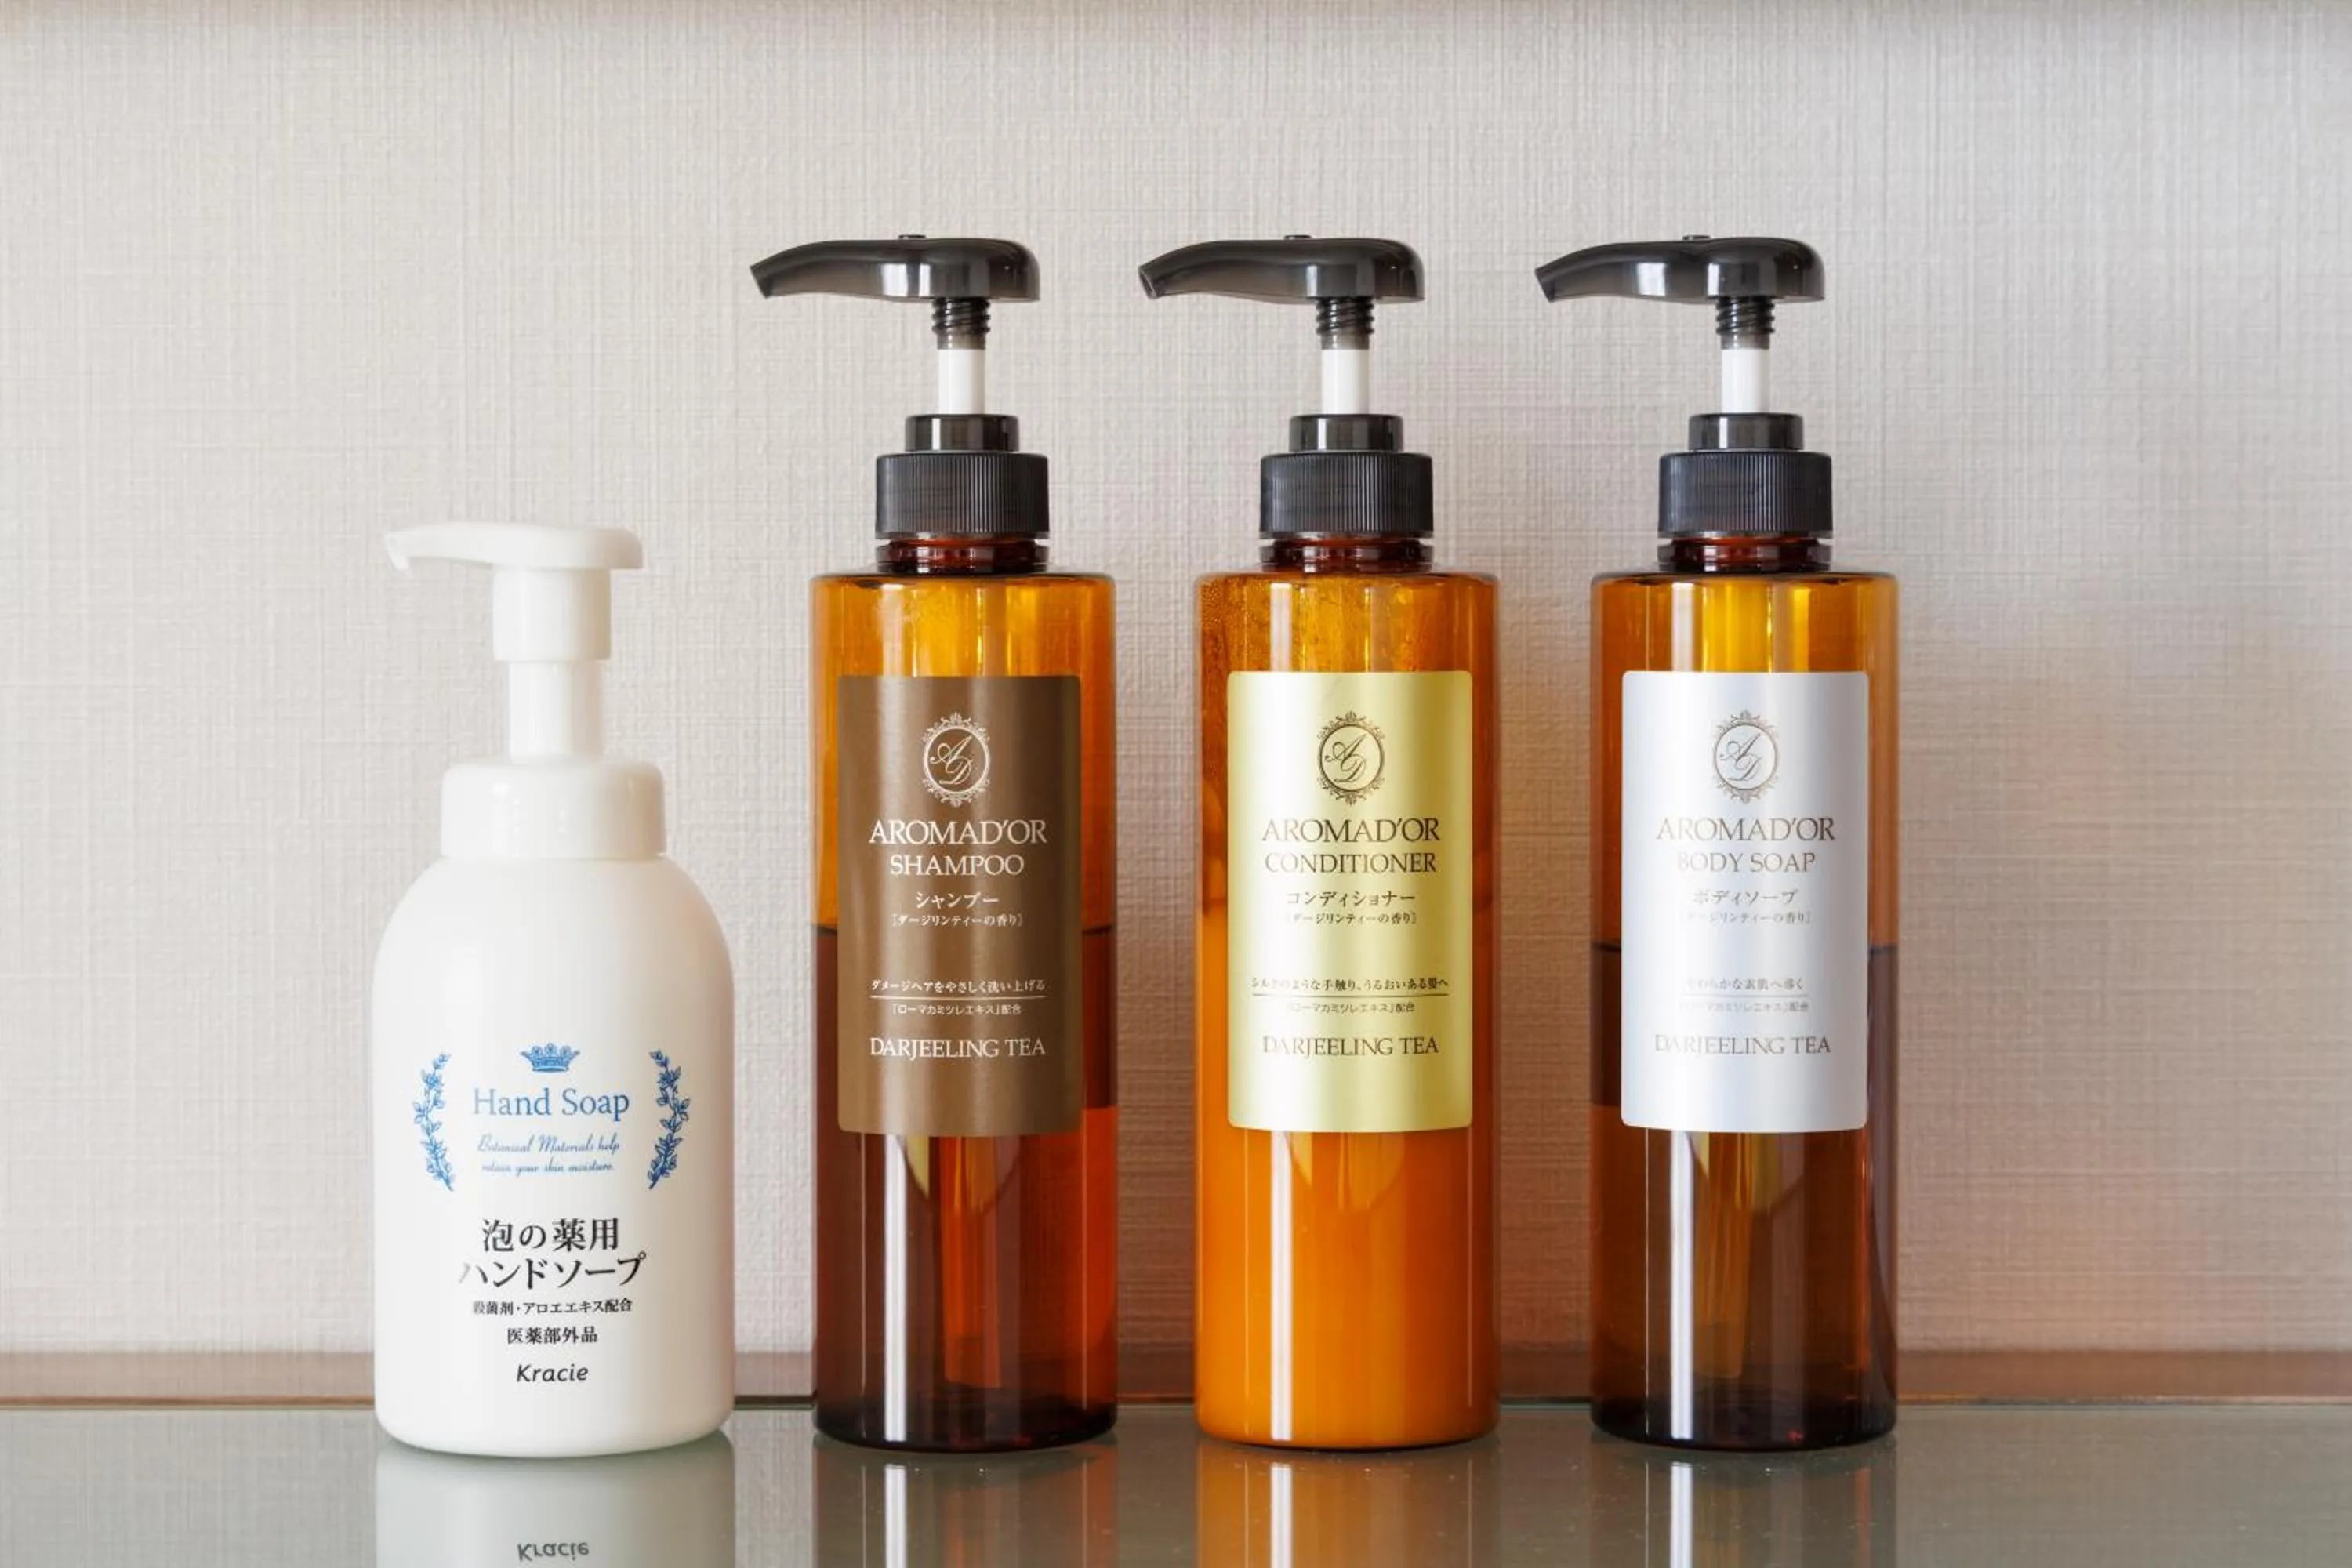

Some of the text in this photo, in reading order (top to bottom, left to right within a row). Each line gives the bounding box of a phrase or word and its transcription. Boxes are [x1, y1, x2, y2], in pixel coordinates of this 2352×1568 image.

[869, 819, 1048, 845] AROMAD'OR
[1261, 818, 1441, 843] AROMAD'OR
[1655, 817, 1835, 842] AROMAD'OR
[890, 854, 1025, 877] SHAMPOO
[1265, 851, 1438, 873] CONDITIONER
[1677, 851, 1817, 873] BODY SOAP
[914, 891, 1000, 909] シャンプー
[1287, 890, 1416, 908] コンディショナー
[1693, 888, 1800, 905] ボディソープ
[869, 1036, 1047, 1062] DARJEELING TEA
[1263, 1035, 1441, 1058] DARJEELING TEA
[1654, 1034, 1832, 1056] DARJEELING TEA
[473, 1087, 630, 1122] Hand Soap
[476, 1131, 621, 1156] Botanical Materials help
[514, 1163, 540, 1178] your
[543, 1156, 564, 1173] skin
[482, 1217, 619, 1253] 泡の薬用
[458, 1250, 647, 1290] ハンドソープ
[473, 1297, 633, 1316] 殺菌剤・アロエエキス配合
[506, 1325, 598, 1346] 医薬部外品
[515, 1363, 590, 1383] Kracie
